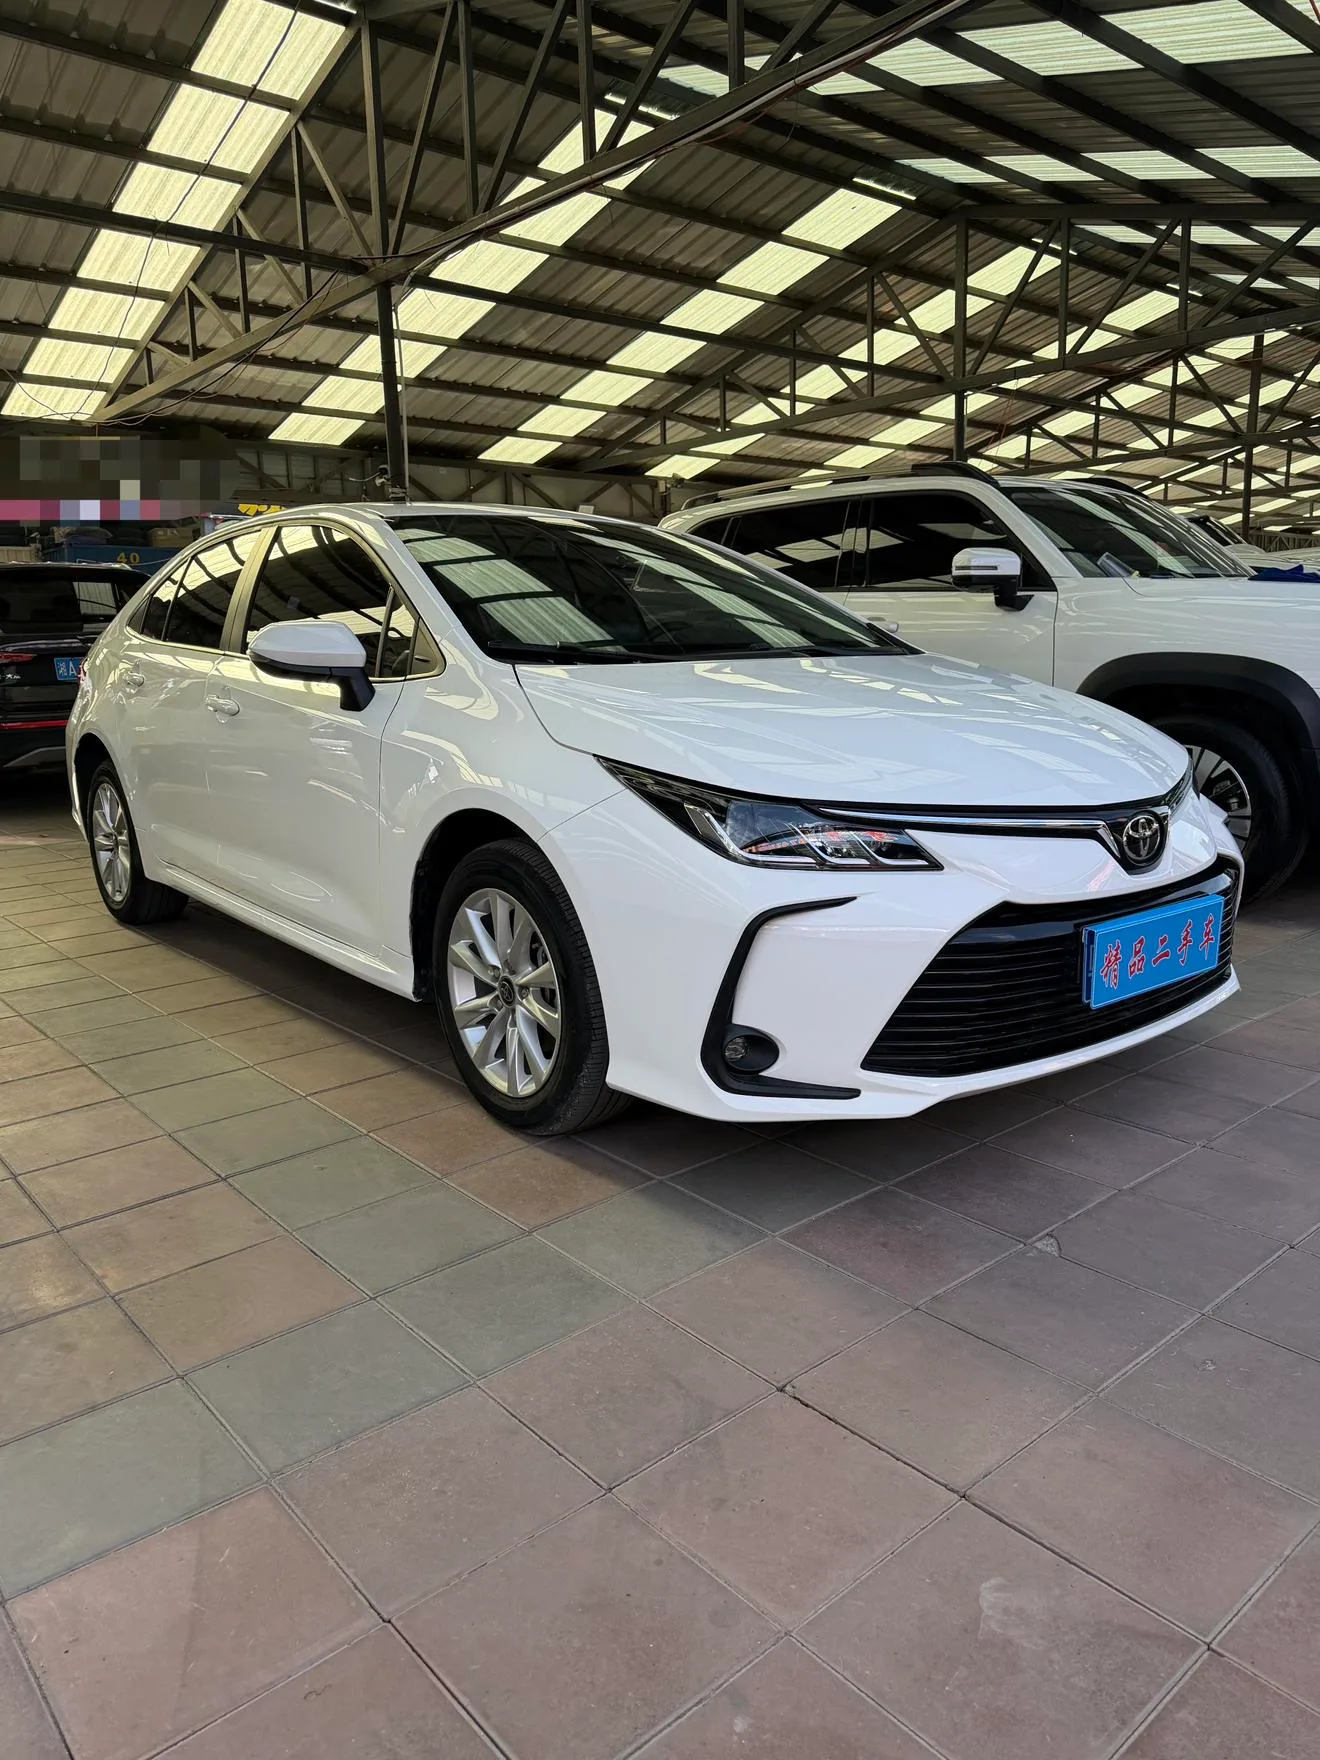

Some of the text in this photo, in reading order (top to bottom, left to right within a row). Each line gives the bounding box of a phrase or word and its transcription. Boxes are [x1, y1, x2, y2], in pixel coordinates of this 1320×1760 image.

[1100, 913, 1215, 989] 精品二手车
